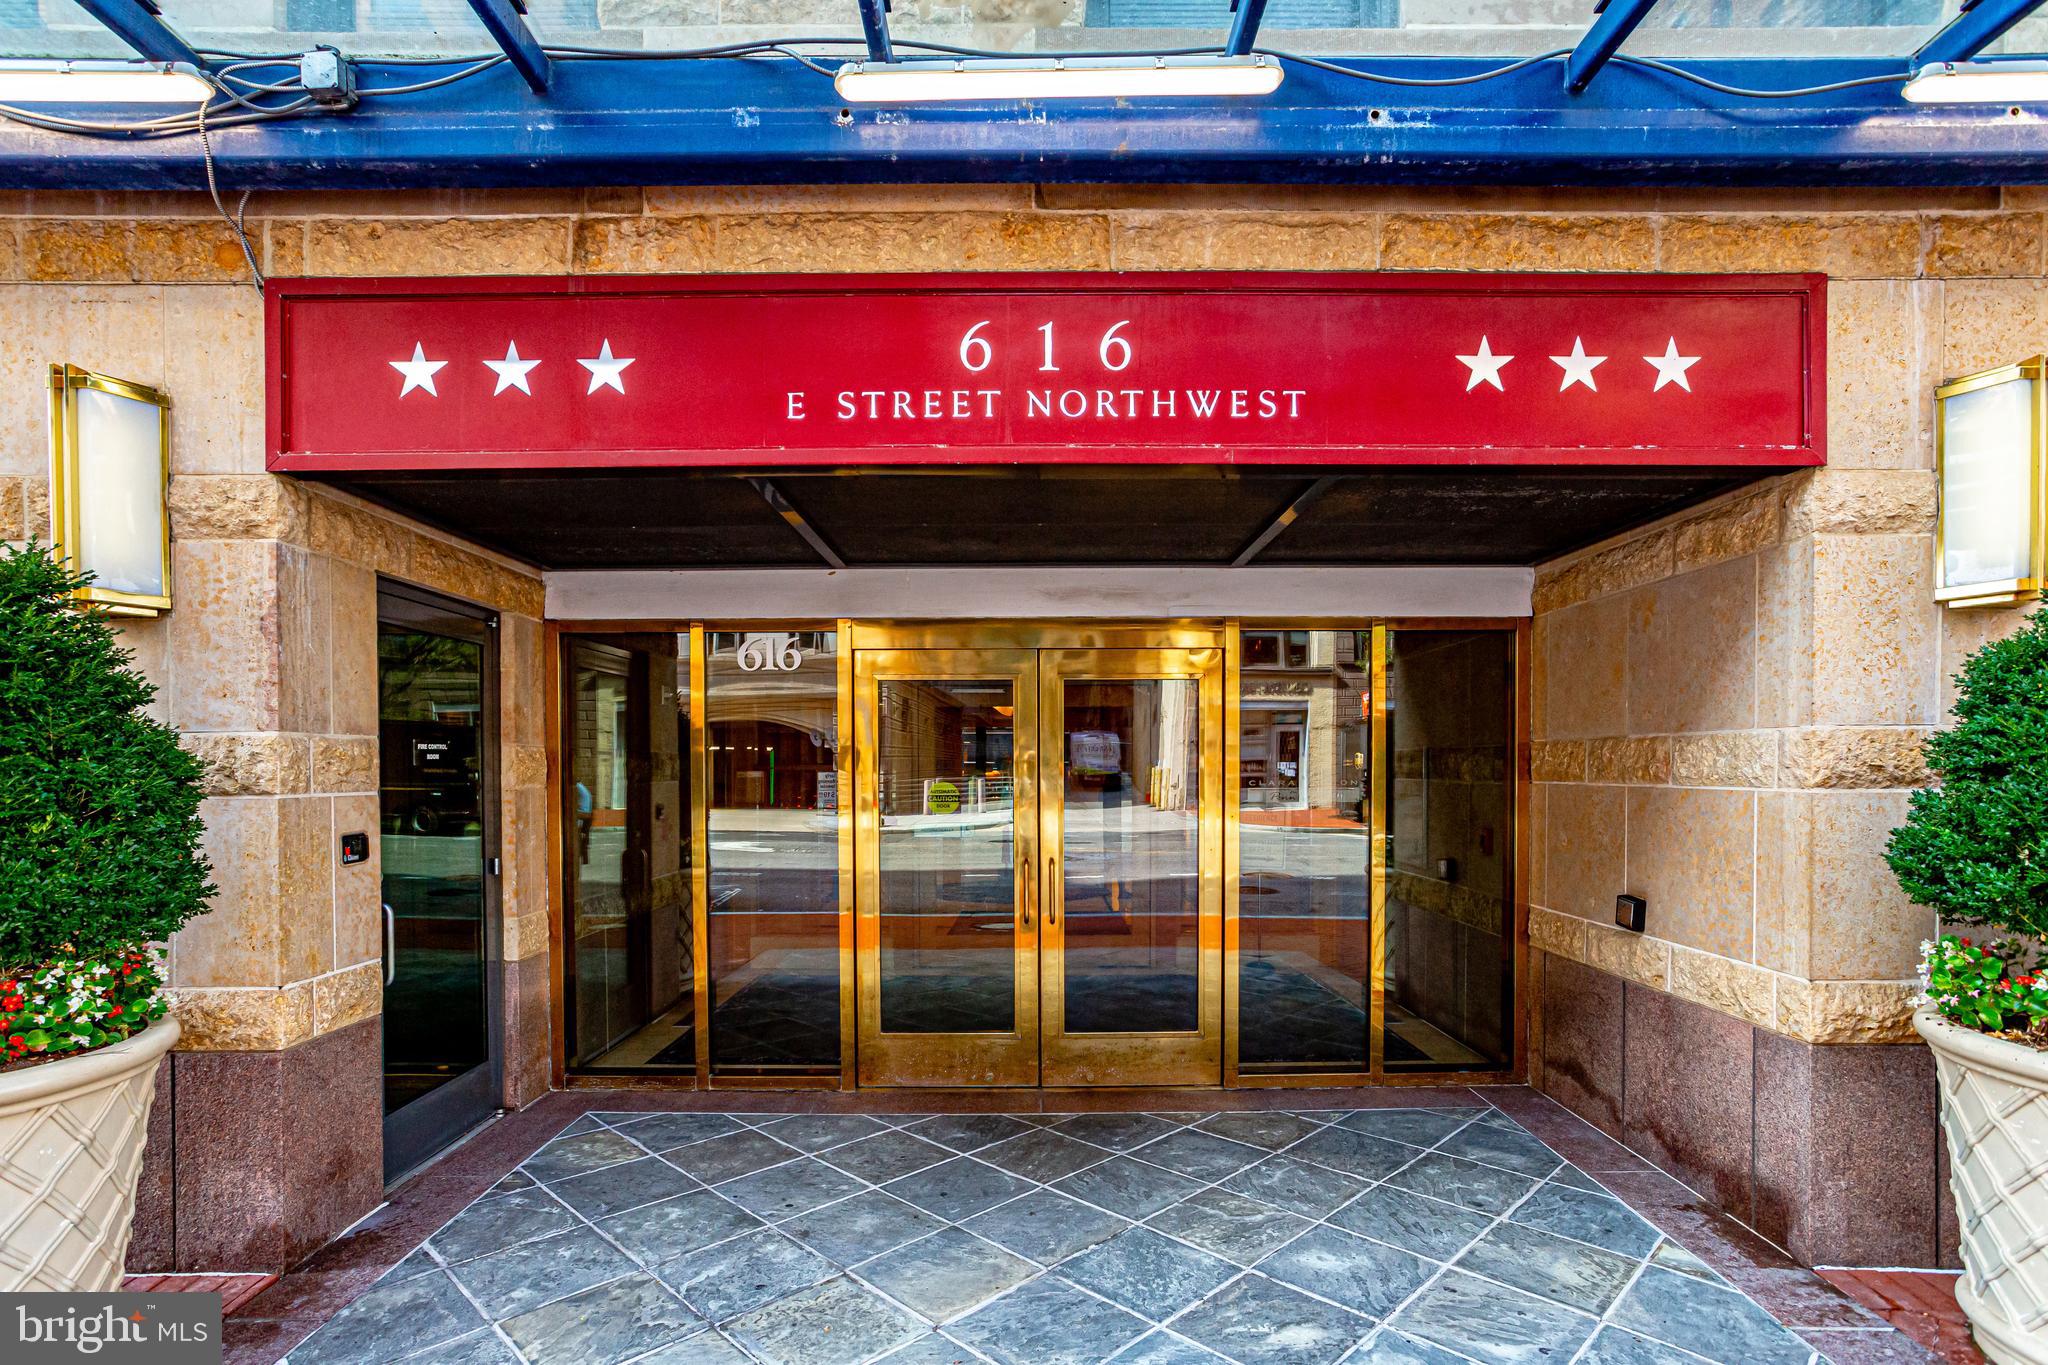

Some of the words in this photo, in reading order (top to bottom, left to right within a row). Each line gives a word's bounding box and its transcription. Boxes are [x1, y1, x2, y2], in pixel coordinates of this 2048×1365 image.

[787, 392, 806, 420] E
[838, 390, 1001, 420] STREET
[1026, 389, 1307, 420] NORTHWEST
[737, 637, 802, 671] 616
